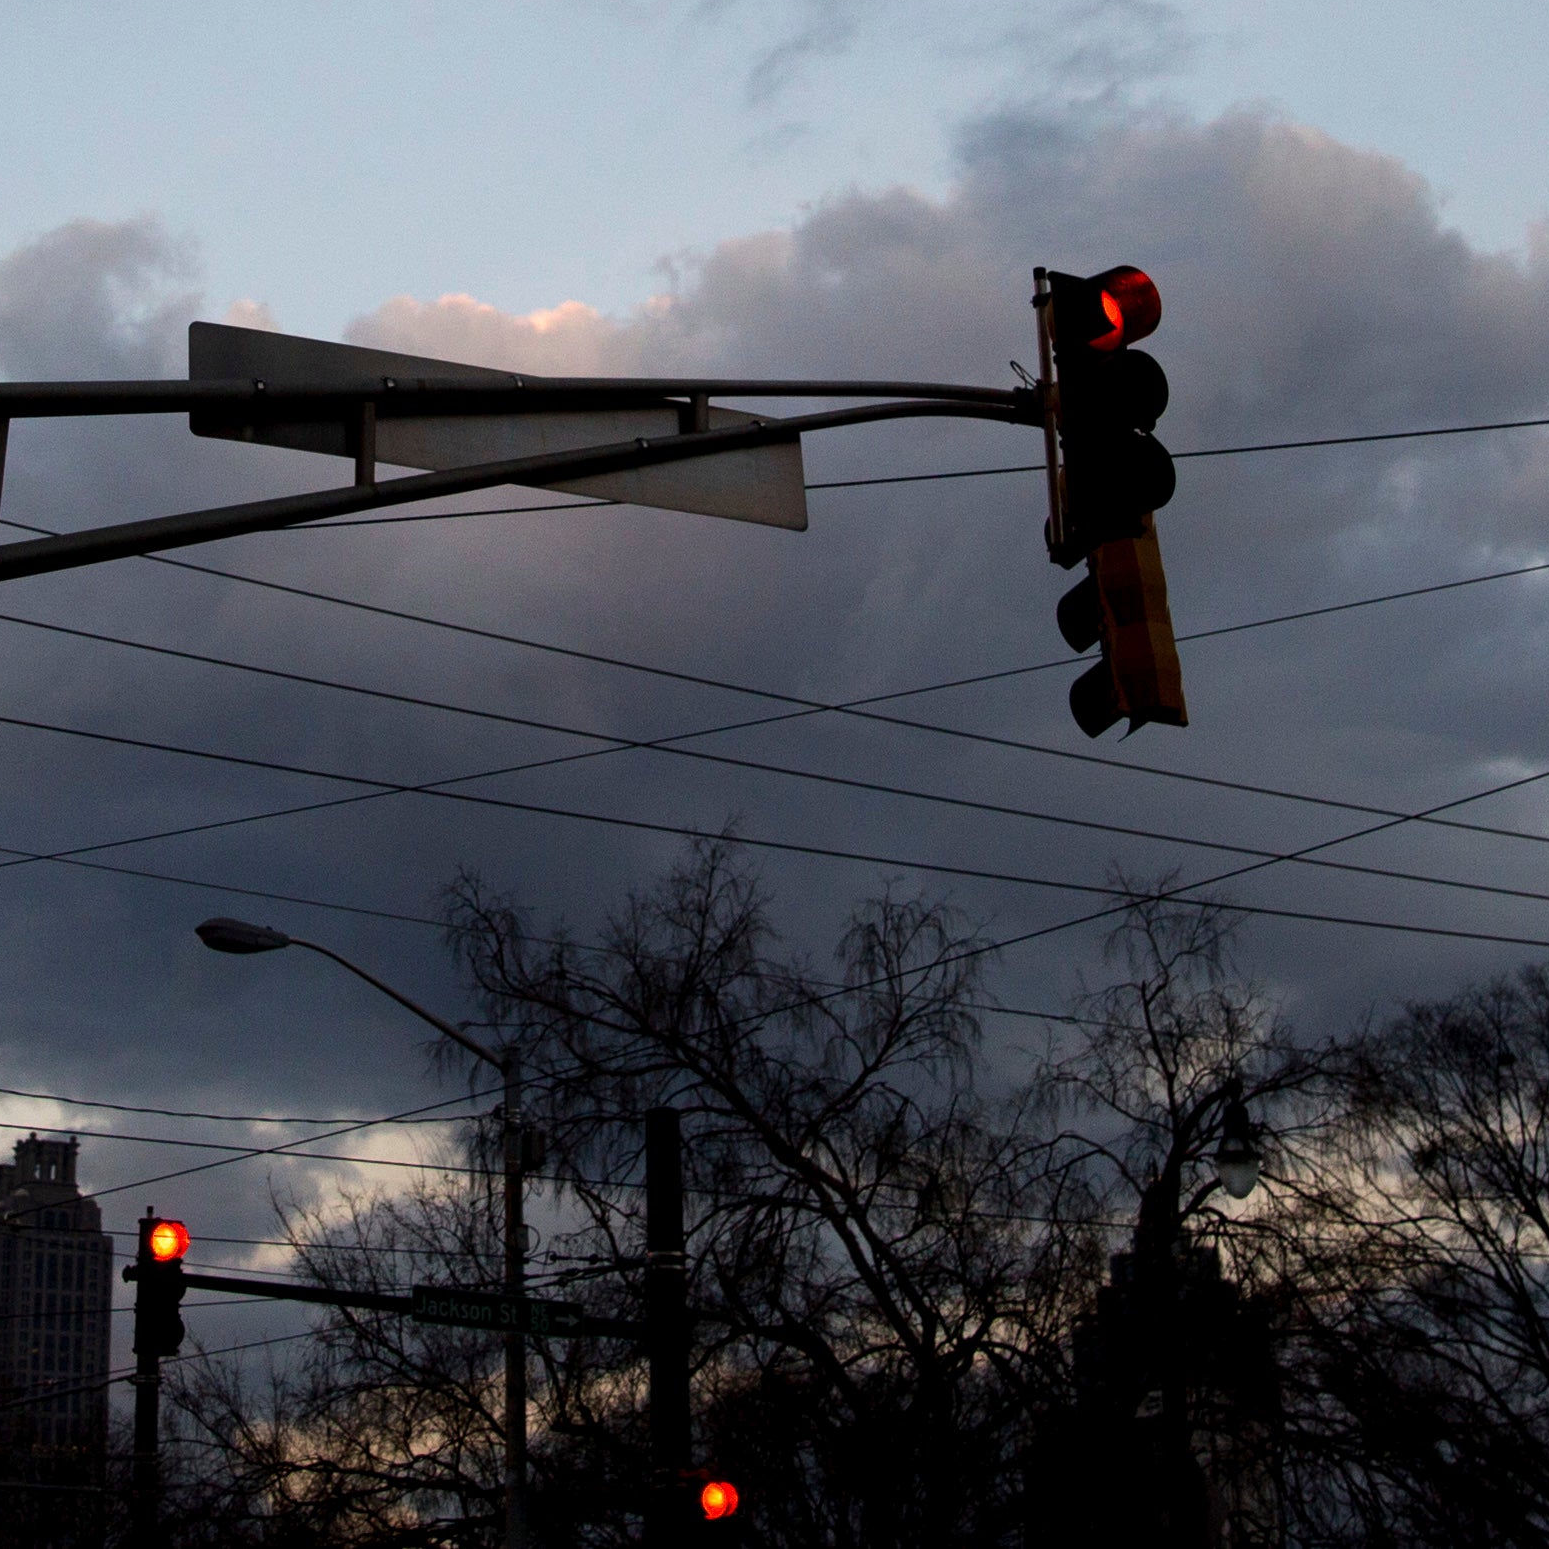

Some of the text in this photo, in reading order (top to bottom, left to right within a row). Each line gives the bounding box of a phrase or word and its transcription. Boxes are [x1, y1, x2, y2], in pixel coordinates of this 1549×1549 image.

[416, 1294, 548, 1325] Jackson St NE
